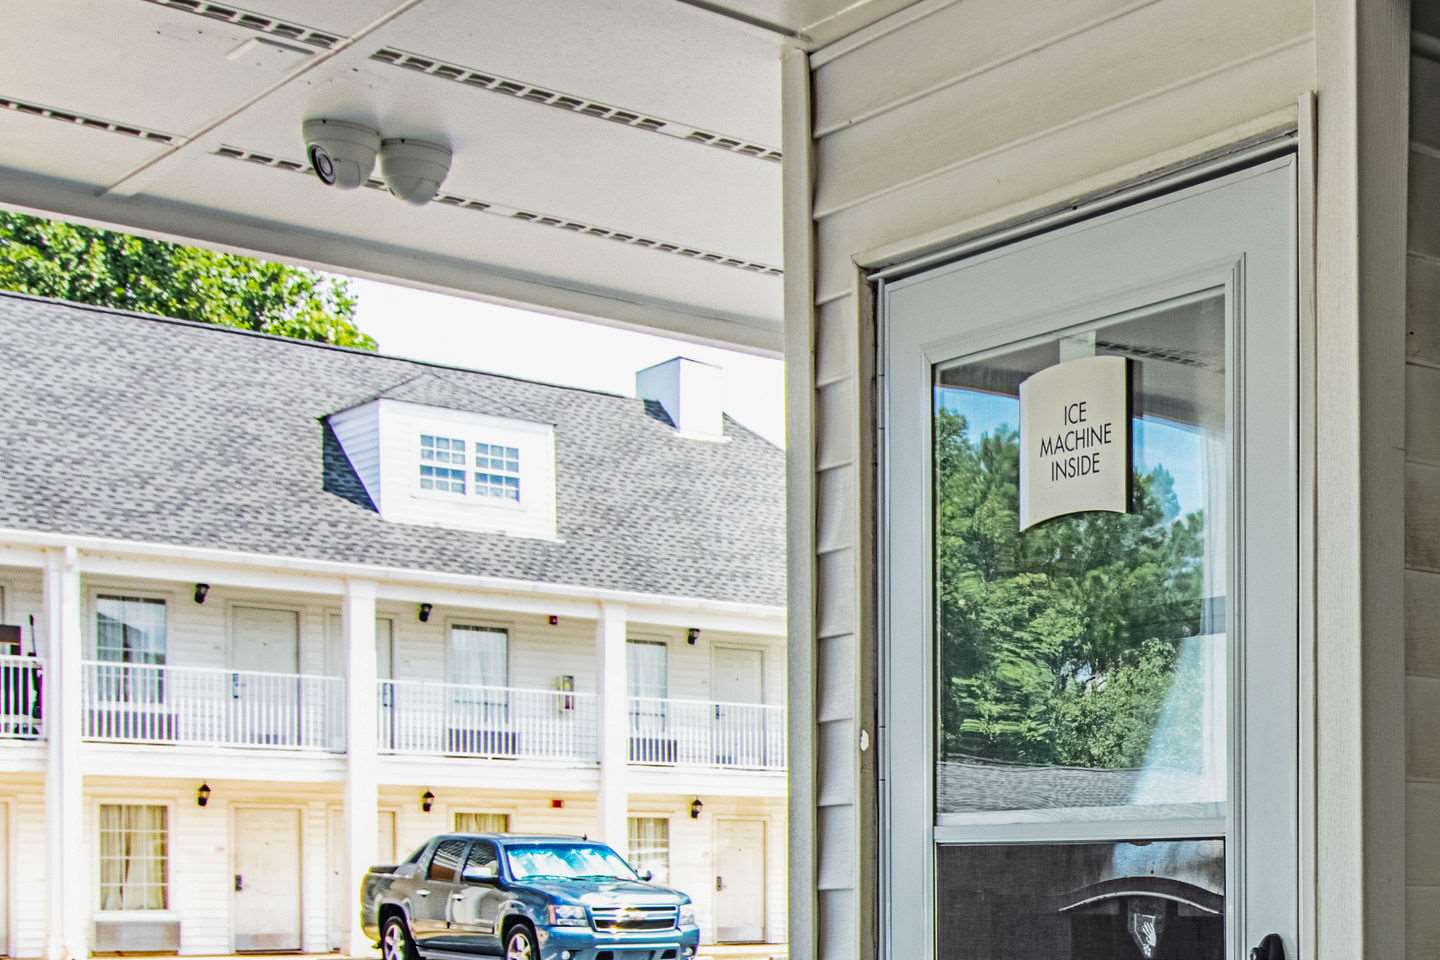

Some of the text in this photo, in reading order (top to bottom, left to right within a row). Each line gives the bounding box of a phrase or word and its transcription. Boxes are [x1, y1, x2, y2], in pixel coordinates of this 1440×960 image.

[1064, 401, 1087, 426] ICE
[1039, 422, 1112, 458] MACHINE
[1051, 452, 1100, 482] INSIDE
